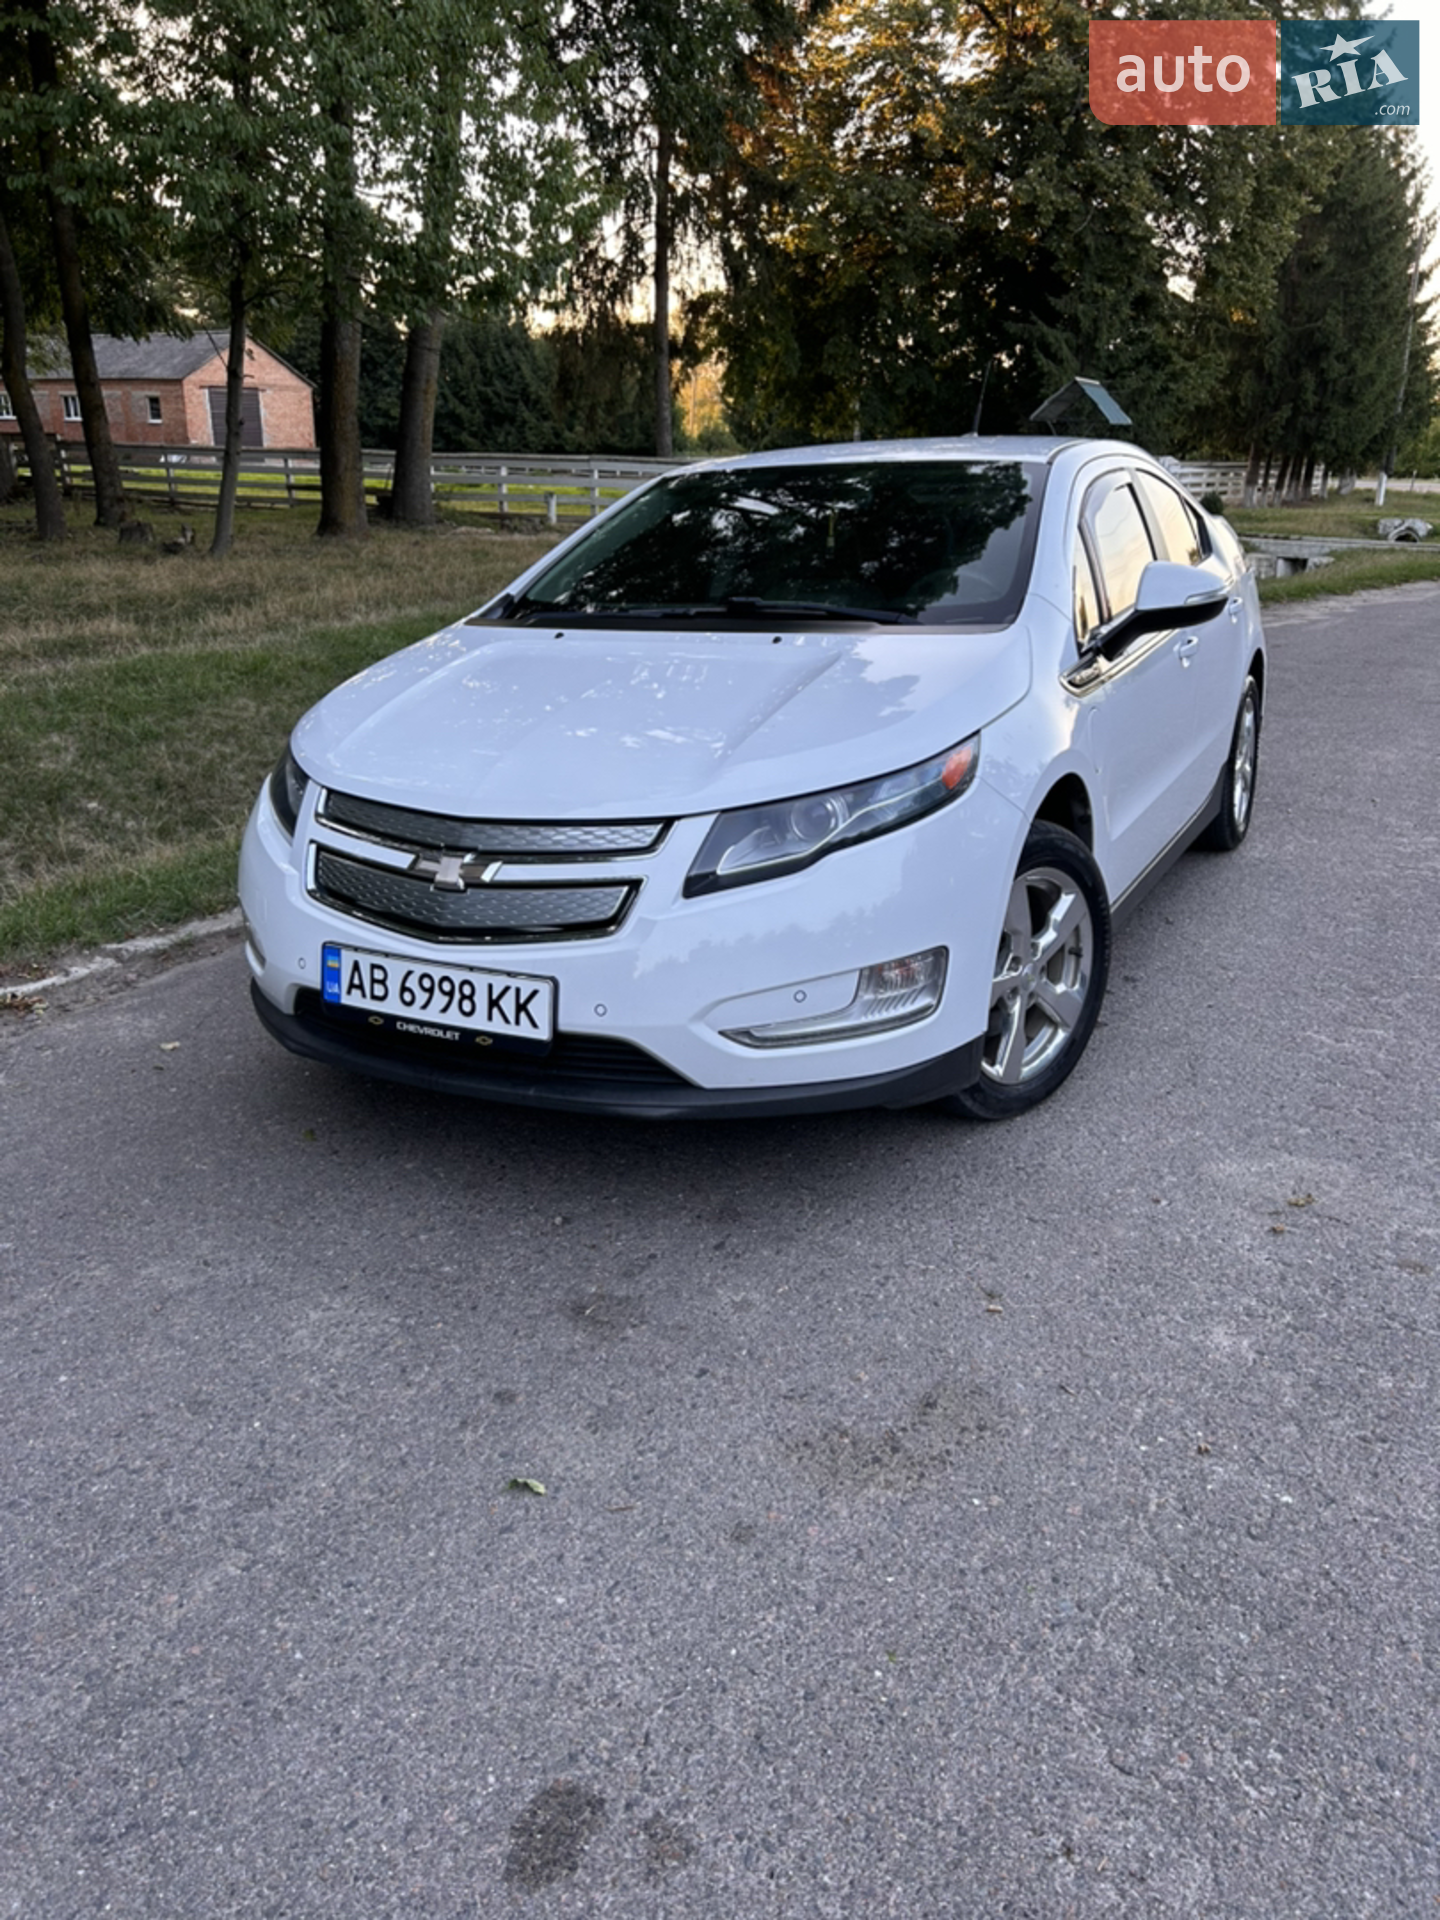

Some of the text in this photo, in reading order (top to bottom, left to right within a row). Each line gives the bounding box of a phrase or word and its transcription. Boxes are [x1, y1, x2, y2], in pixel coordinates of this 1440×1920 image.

[326, 981, 340, 994] UA
[346, 960, 540, 1030] AB 6998 KK
[396, 1020, 461, 1041] CHEVROLET
